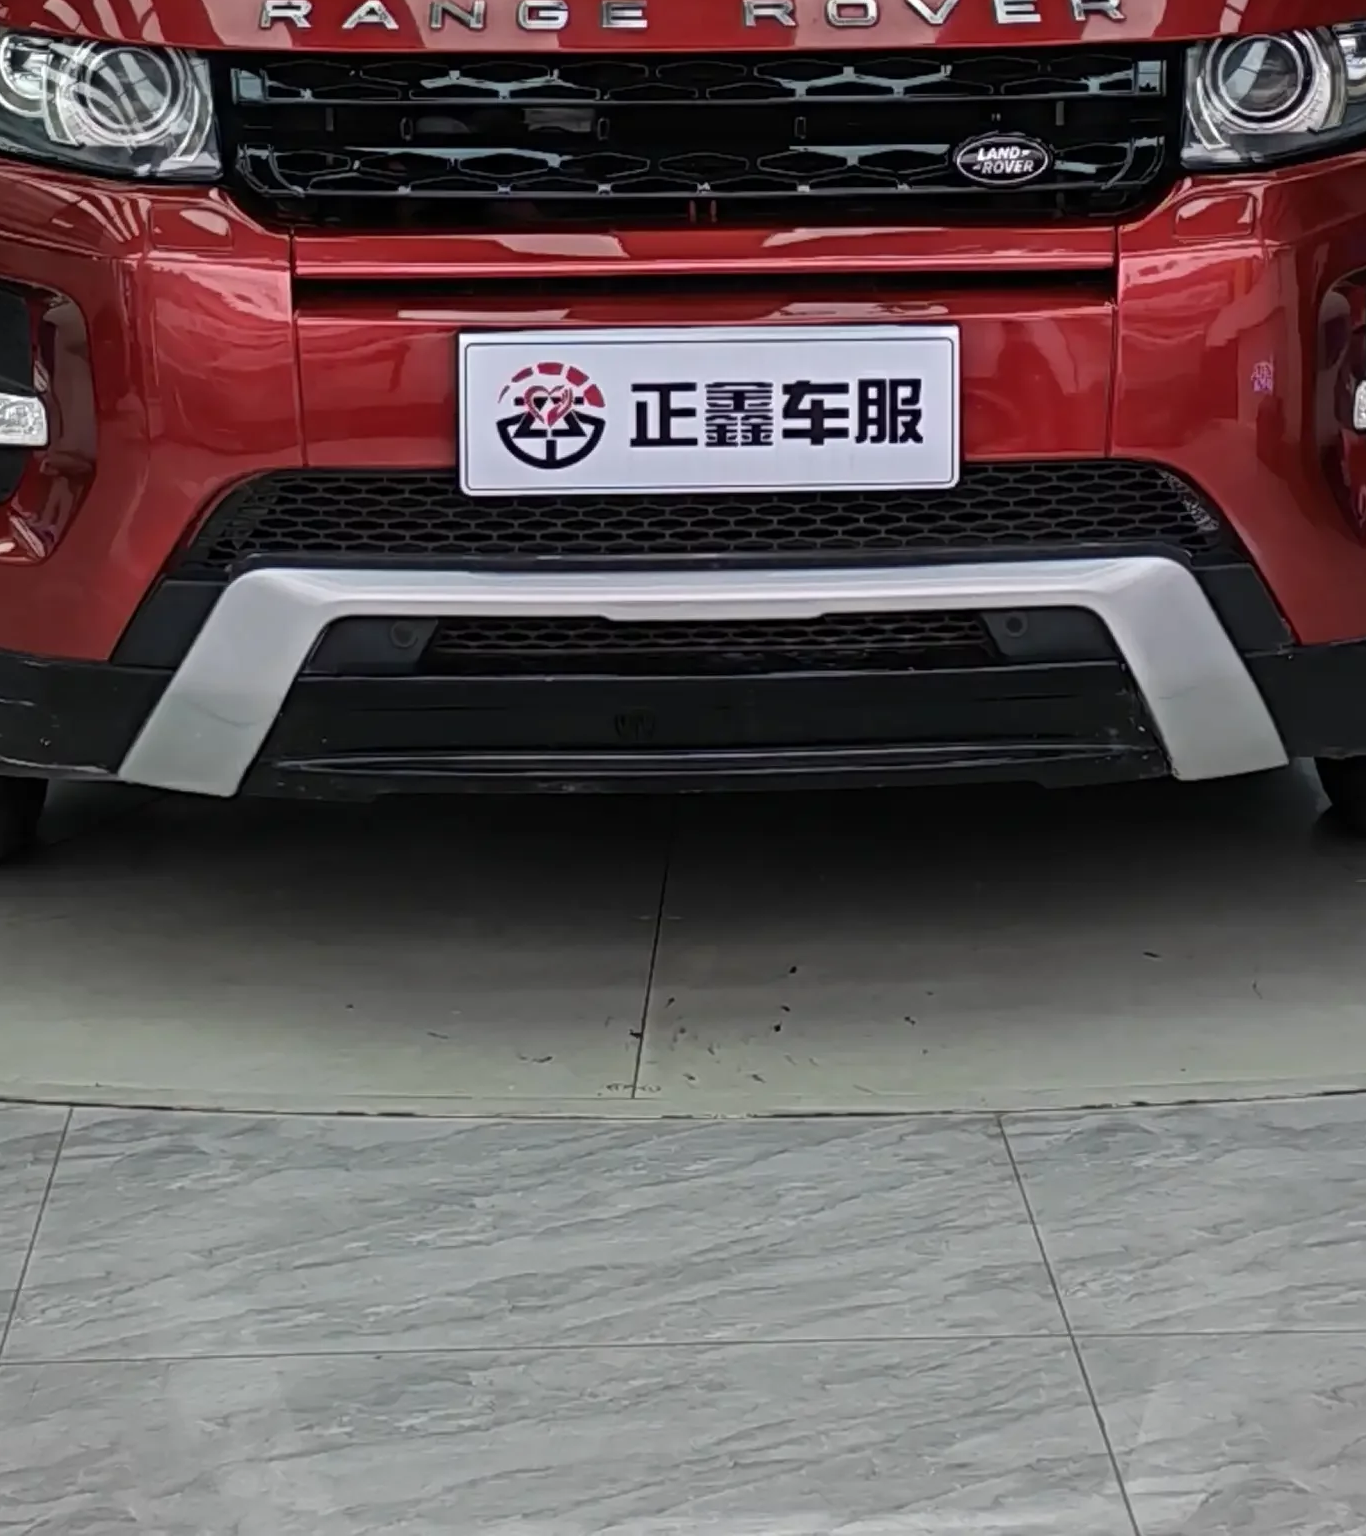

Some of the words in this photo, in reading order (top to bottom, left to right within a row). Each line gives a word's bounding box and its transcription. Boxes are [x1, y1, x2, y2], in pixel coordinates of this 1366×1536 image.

[977, 145, 1021, 161] LAND
[981, 160, 1034, 175] ROVER
[630, 378, 924, 447] 正鑫车服
